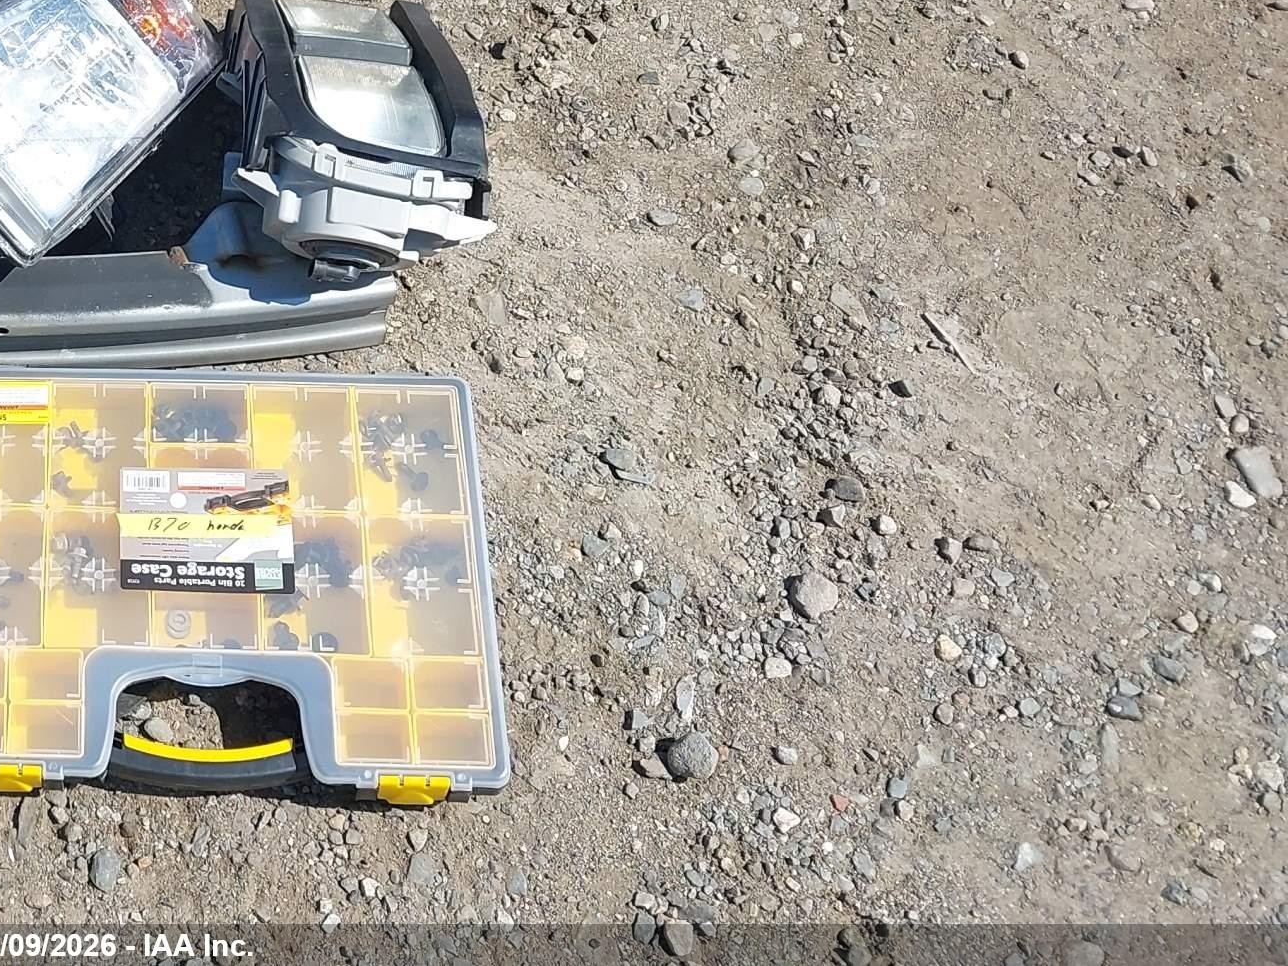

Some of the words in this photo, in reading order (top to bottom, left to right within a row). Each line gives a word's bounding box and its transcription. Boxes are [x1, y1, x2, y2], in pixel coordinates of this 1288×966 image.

[130, 563, 173, 578] Case
[176, 561, 245, 580] Storage
[153, 577, 177, 586] Parts
[179, 577, 216, 587] Portable
[218, 579, 232, 587] Bin
[235, 579, 246, 587] 20
